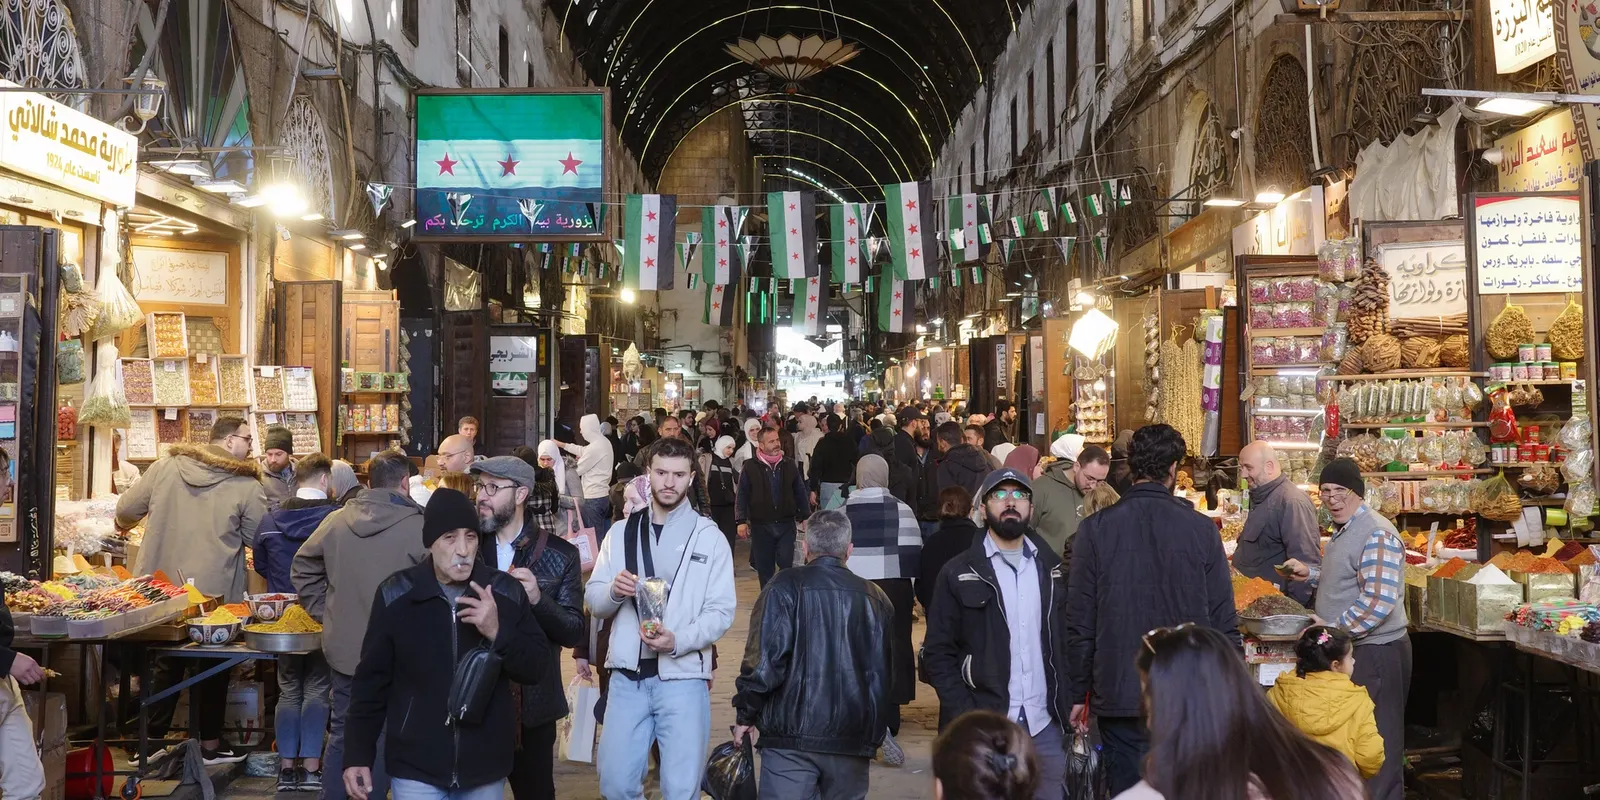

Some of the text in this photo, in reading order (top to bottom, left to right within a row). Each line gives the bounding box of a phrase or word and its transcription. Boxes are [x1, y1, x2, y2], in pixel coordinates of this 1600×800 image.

[1494, 0, 1532, 42] البزرة
[9, 99, 58, 142] شالاتي
[60, 123, 98, 158] محمد
[1526, 133, 1558, 166] سعيد
[46, 152, 63, 171] 1924
[1500, 137, 1524, 177] البزرة
[63, 160, 76, 180] عام
[425, 213, 446, 231] بكم
[492, 213, 523, 231] الكرم
[1480, 213, 1521, 228] ولوازمها
[1523, 211, 1553, 226] فاخرة
[1481, 232, 1580, 248] ارات فلفل كمون
[1507, 254, 1535, 268] بابريكا
[1483, 274, 1521, 288] زهورات
[1528, 273, 1560, 287] سكاكر
